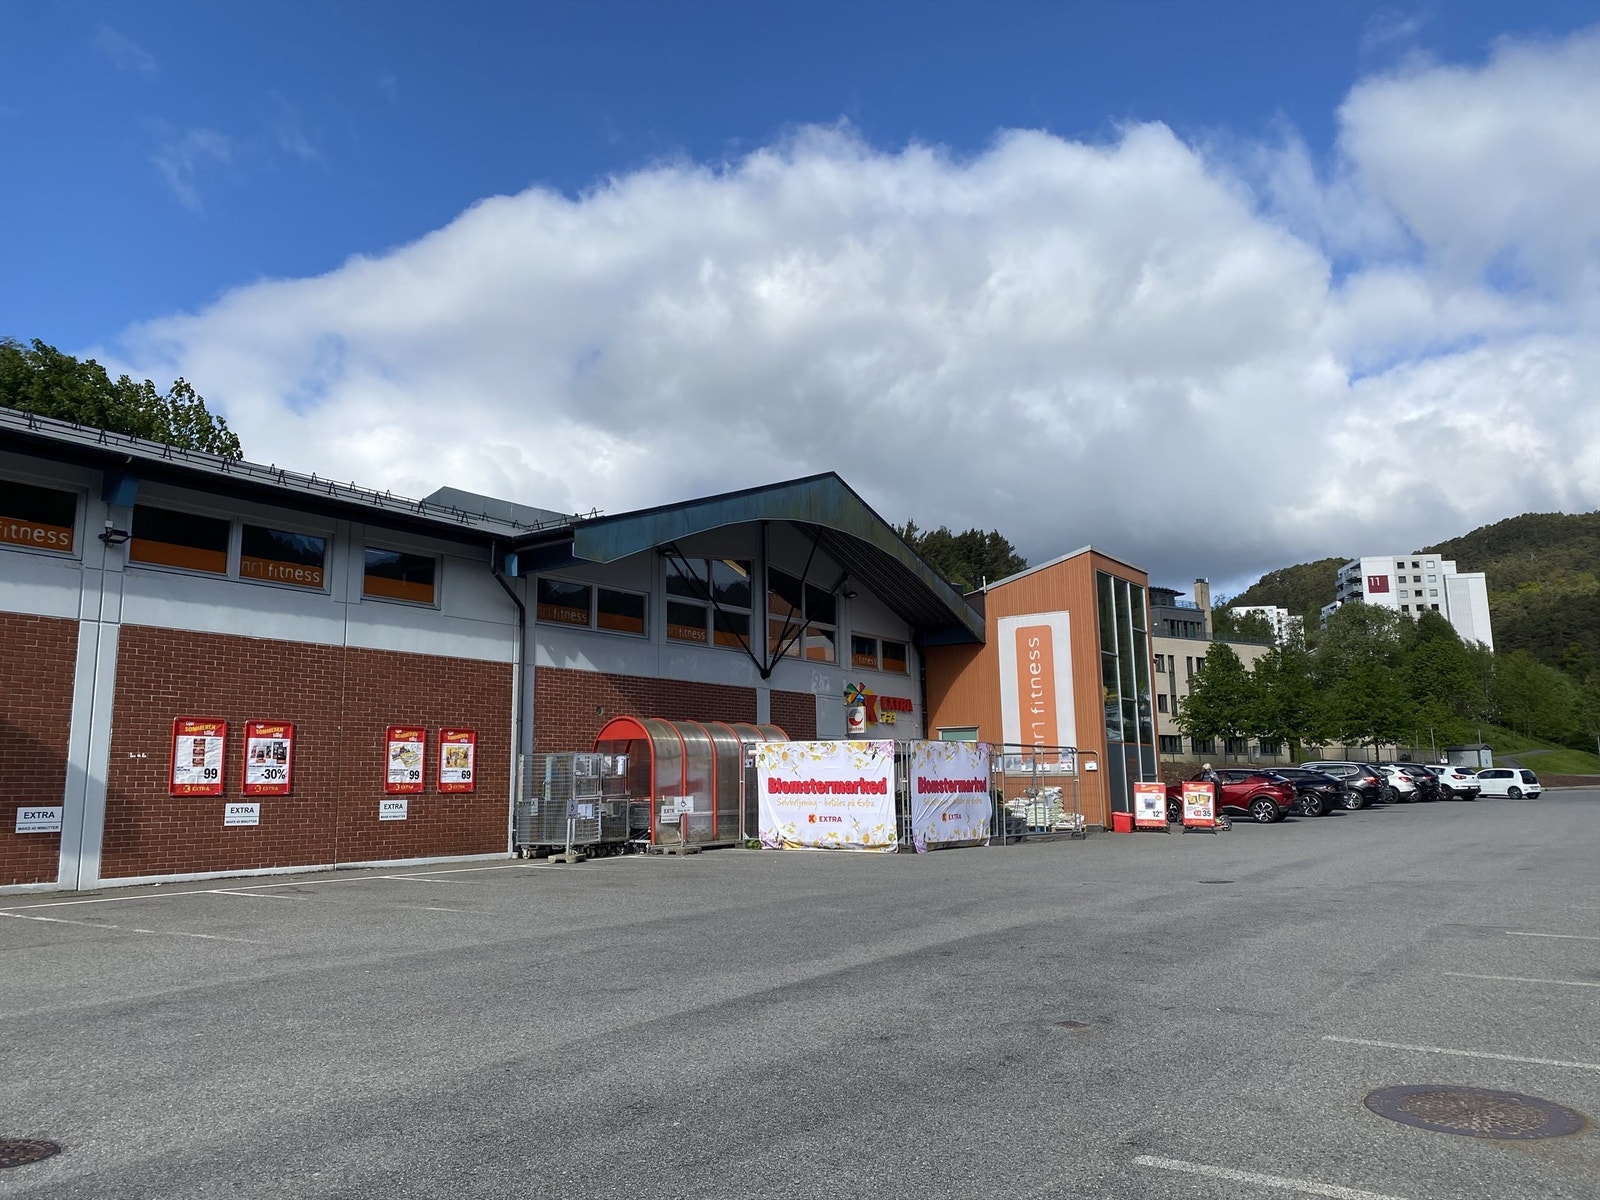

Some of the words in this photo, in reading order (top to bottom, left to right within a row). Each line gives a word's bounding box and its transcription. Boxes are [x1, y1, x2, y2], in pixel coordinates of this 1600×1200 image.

[241, 560, 263, 577] nr1
[268, 563, 320, 583] fitness
[1369, 577, 1380, 586] 11
[553, 608, 588, 623] fitness
[679, 627, 706, 640] fitness
[1028, 636, 1045, 715] fitness
[880, 695, 913, 712] EXTRA
[203, 768, 218, 779] 99
[260, 768, 286, 780] -30%
[409, 770, 420, 780] 99
[461, 770, 471, 779] 69
[767, 776, 888, 795] Blomstermarked
[23, 811, 55, 819] EXTRA
[230, 806, 255, 814] EXTRA
